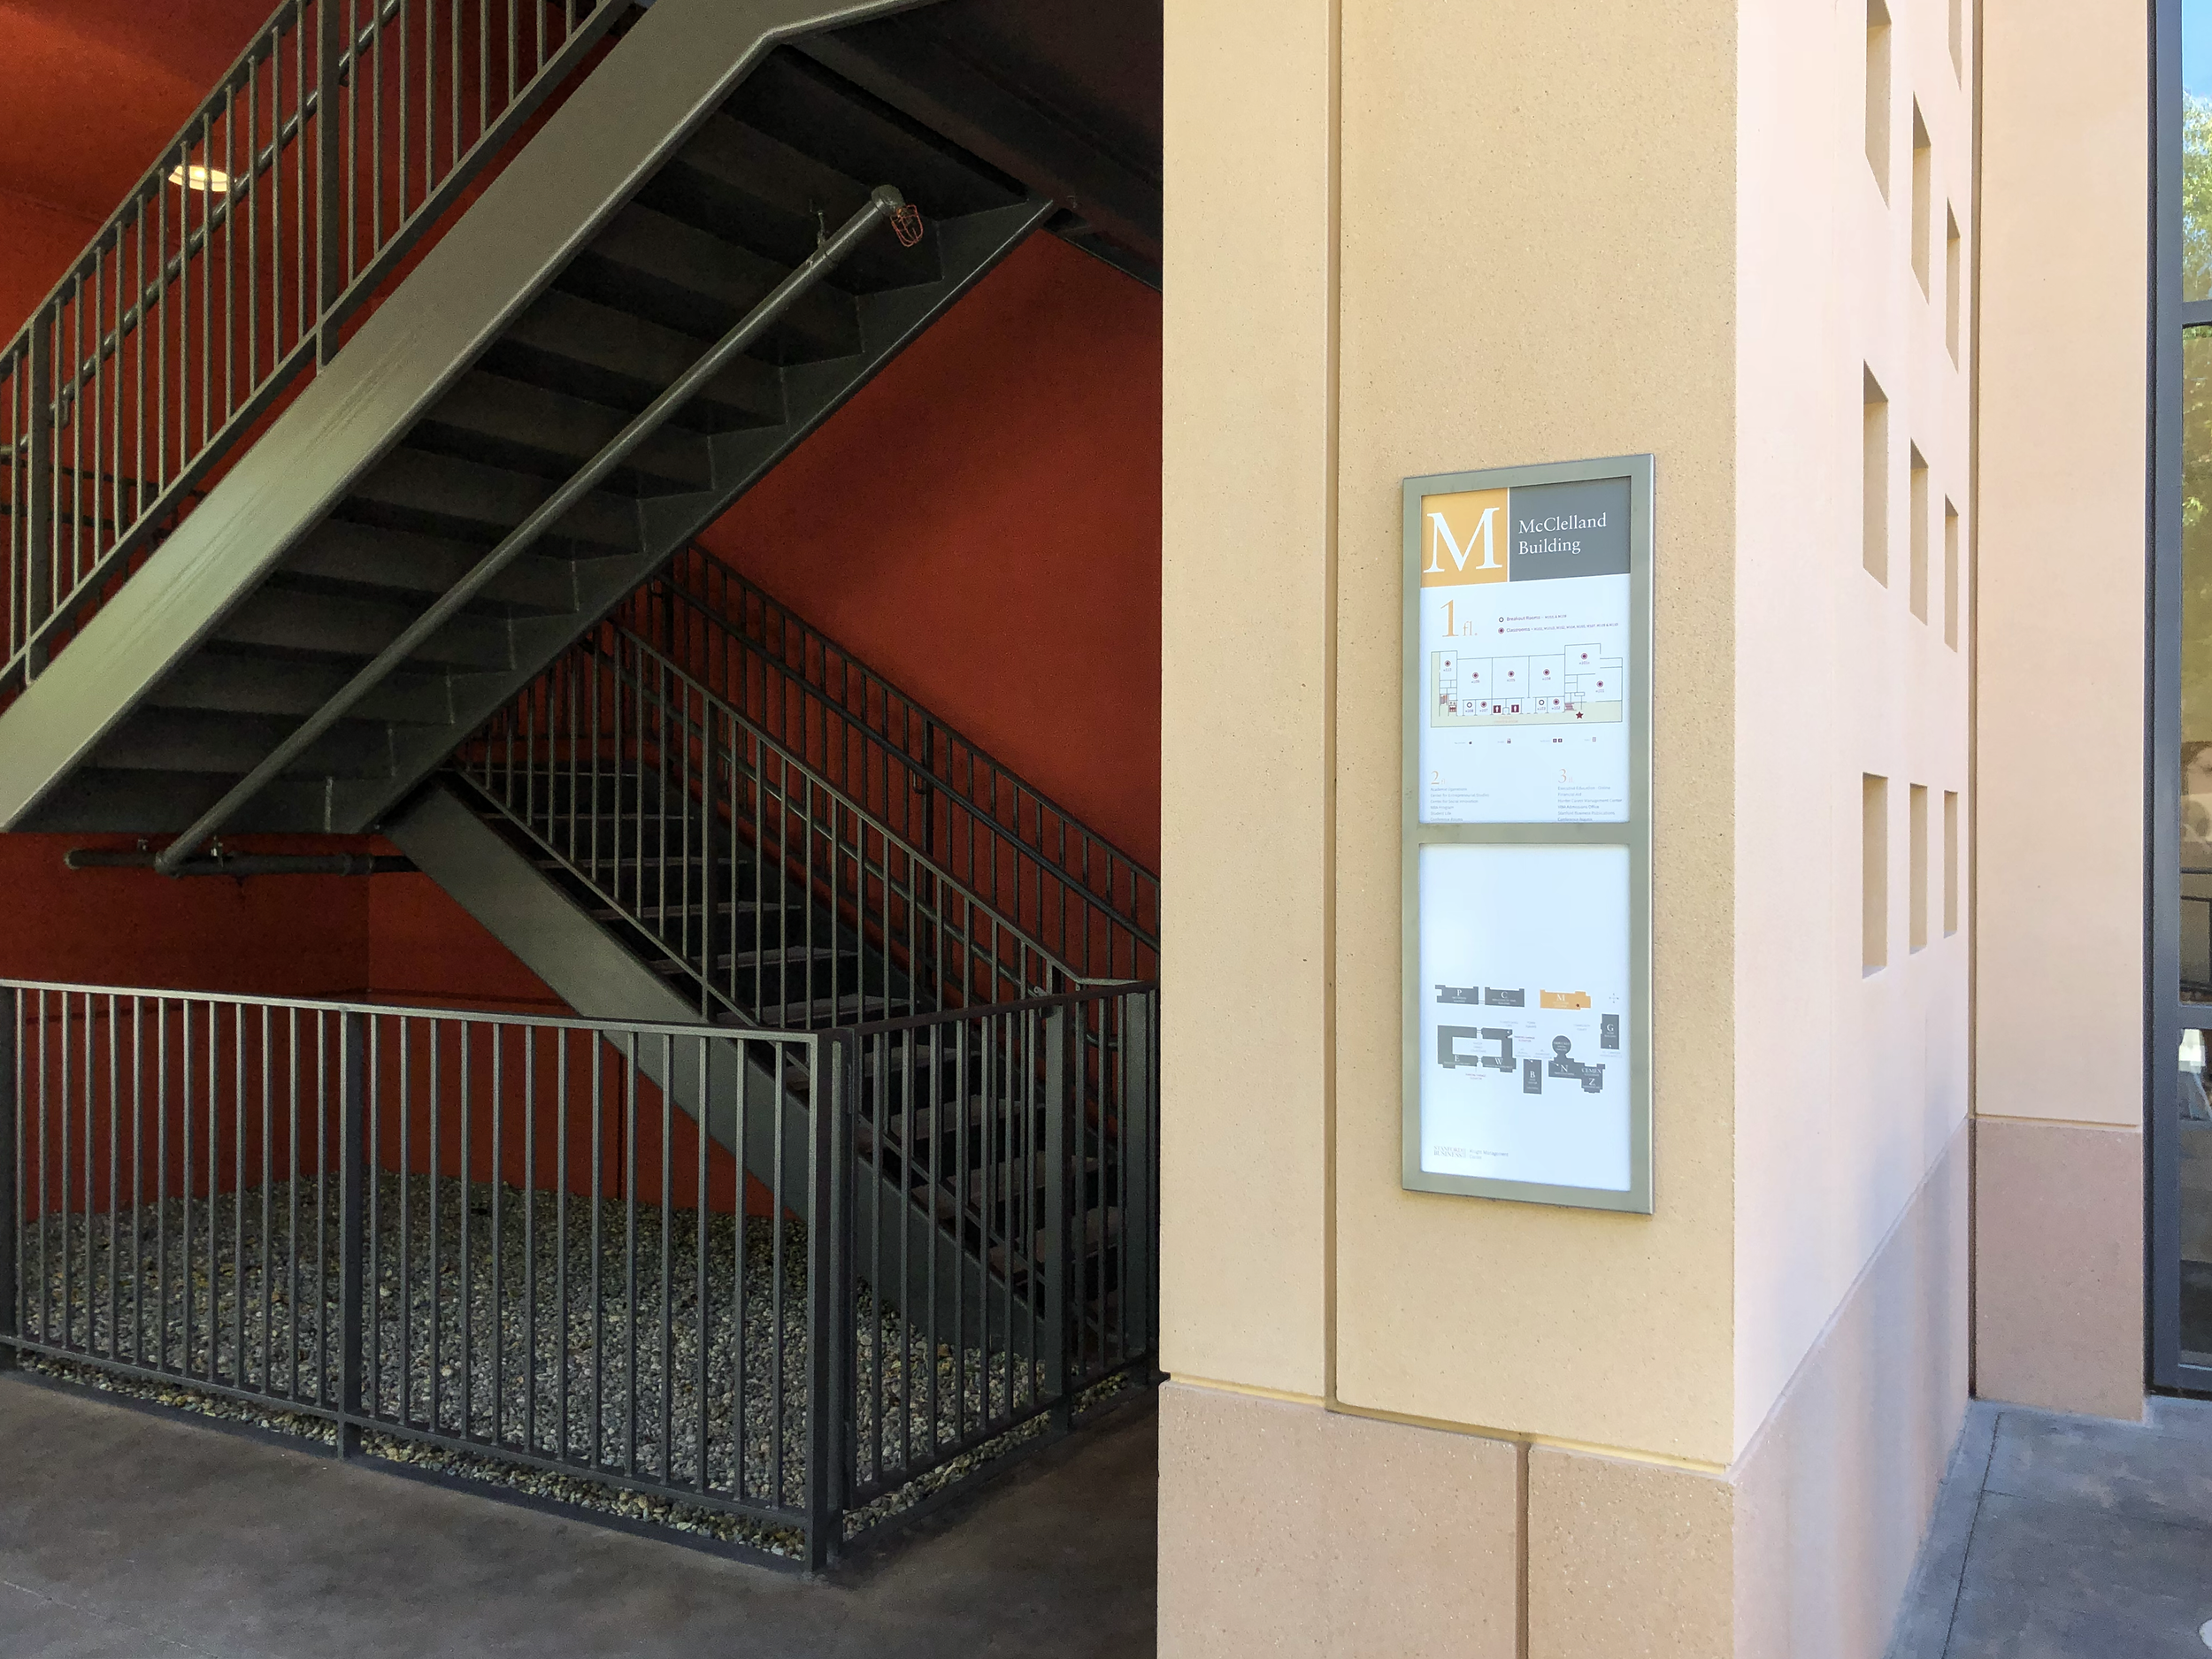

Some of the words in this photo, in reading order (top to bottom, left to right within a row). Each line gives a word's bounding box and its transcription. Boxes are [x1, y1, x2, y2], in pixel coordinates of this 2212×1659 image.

[1518, 512, 1607, 534] McClelland
[1424, 507, 1502, 572] M
[1518, 538, 1581, 555] Building
[1440, 600, 1458, 637] 1
[1431, 771, 1440, 785] 2
[1558, 768, 1566, 784] 3
